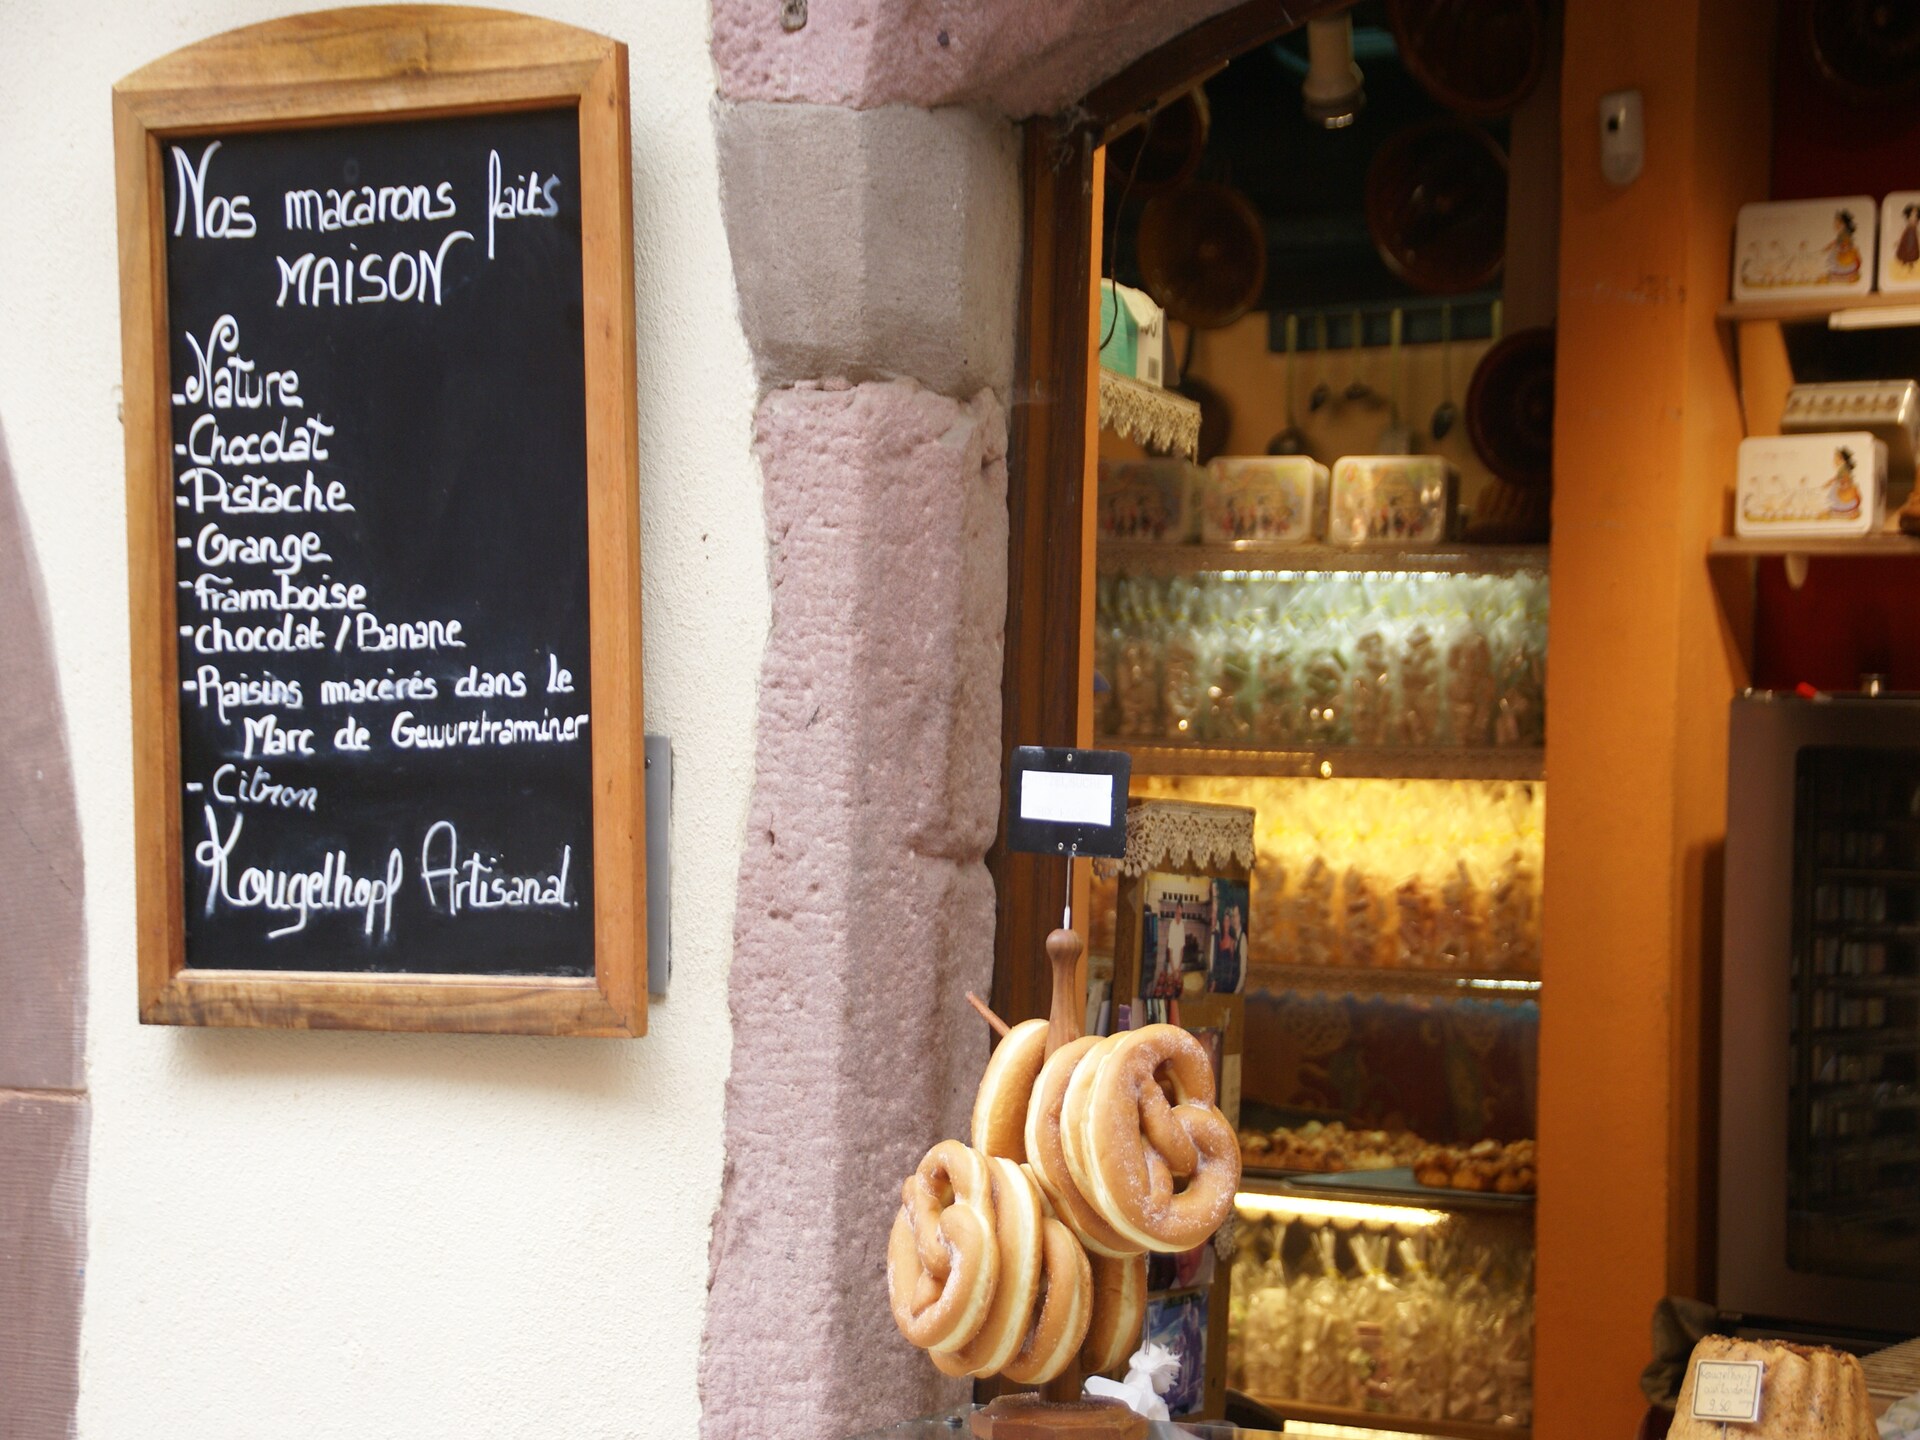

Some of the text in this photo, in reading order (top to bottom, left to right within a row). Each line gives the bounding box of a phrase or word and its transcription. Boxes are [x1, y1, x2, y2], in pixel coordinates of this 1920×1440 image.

[172, 141, 561, 259] Nos macarons faits
[321, 668, 438, 703] macérés
[455, 666, 527, 697] dans
[547, 653, 575, 694] le
[243, 708, 589, 759] Marc de Gewurztraminer
[196, 804, 404, 942] Kougelhopf
